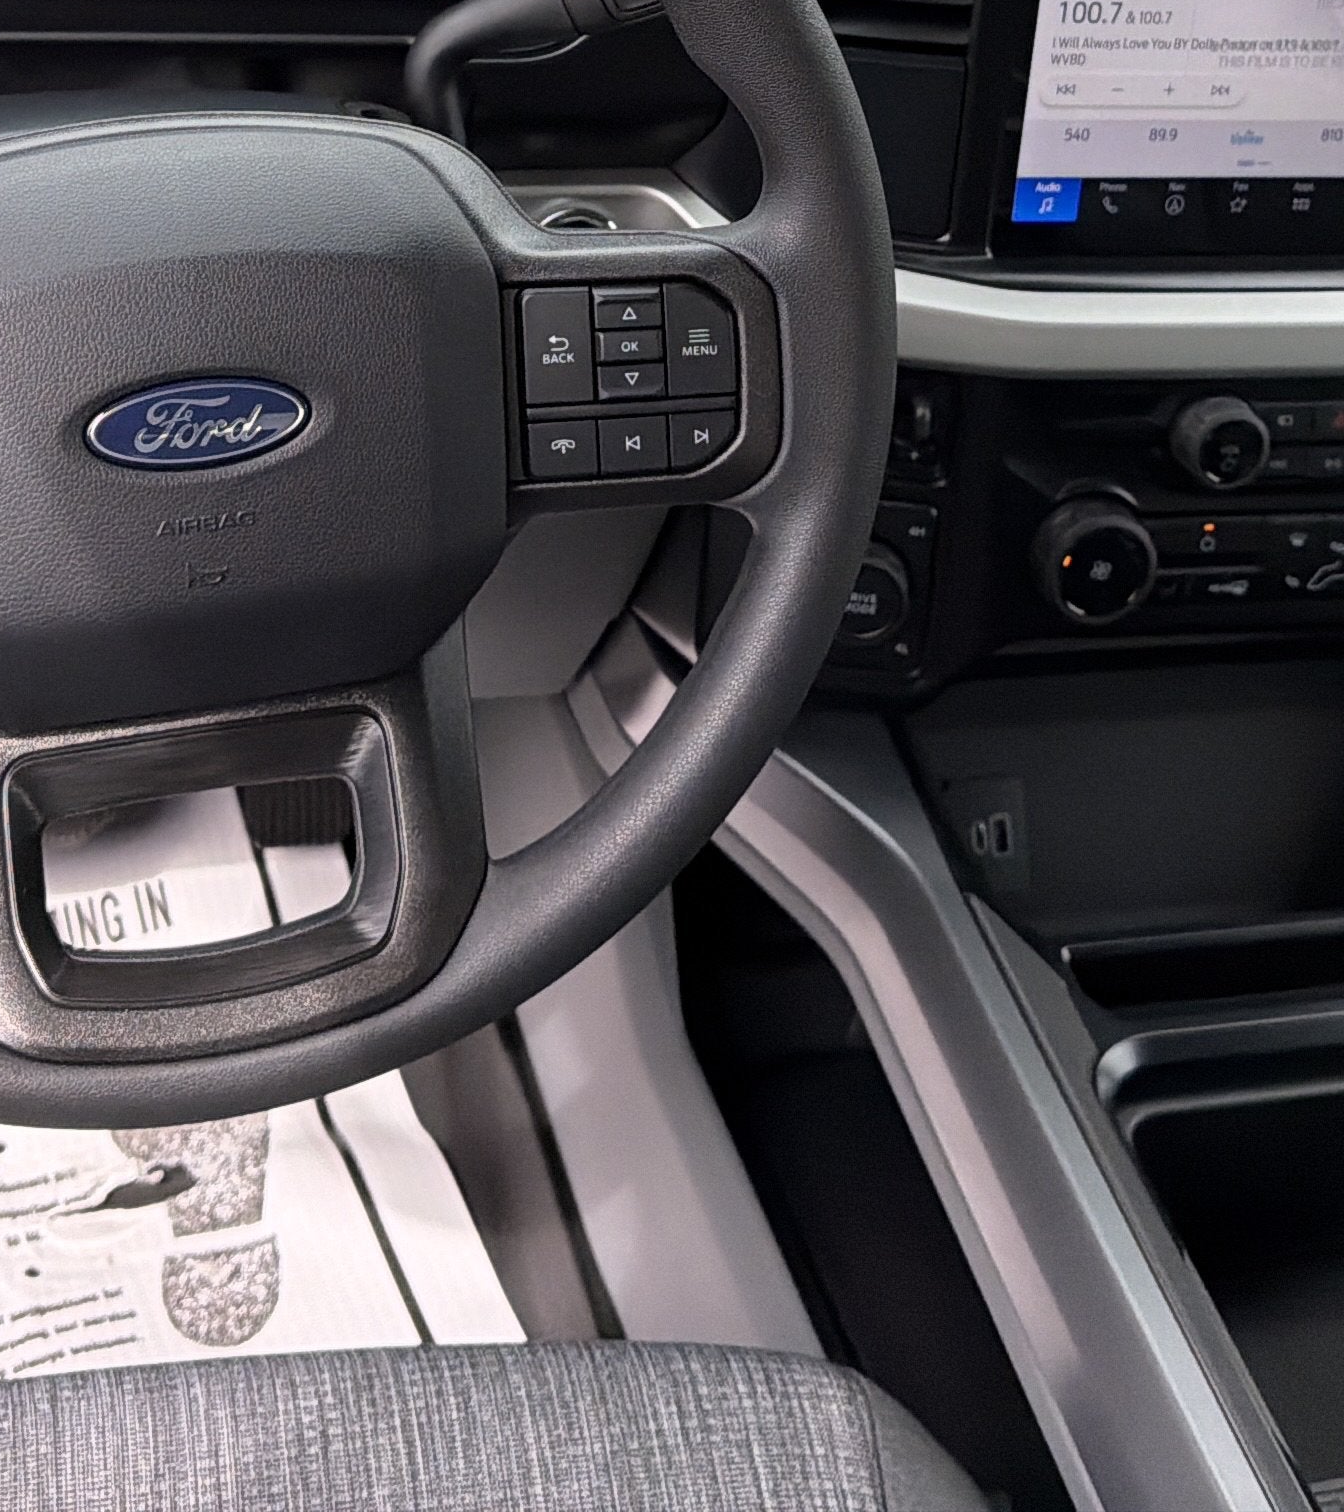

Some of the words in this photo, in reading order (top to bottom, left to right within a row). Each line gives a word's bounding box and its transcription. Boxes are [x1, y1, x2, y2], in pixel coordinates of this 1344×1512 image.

[1059, 0, 1123, 24] 100.7
[1125, 10, 1136, 25] &
[1139, 10, 1173, 25] 100.7
[1058, 36, 1081, 50] Will
[1081, 37, 1121, 52] Always
[1122, 38, 1149, 50] Love
[1151, 38, 1172, 50] You
[1173, 38, 1189, 50] BY
[1064, 127, 1090, 142] 540
[1148, 127, 1178, 142] 89.9
[1035, 182, 1062, 193] Audio
[621, 340, 640, 353] OK
[681, 344, 719, 357] MENU
[542, 351, 576, 366] BACK
[133, 394, 264, 454] Ford
[156, 510, 256, 538] AIRBAG
[132, 877, 173, 934] IN
